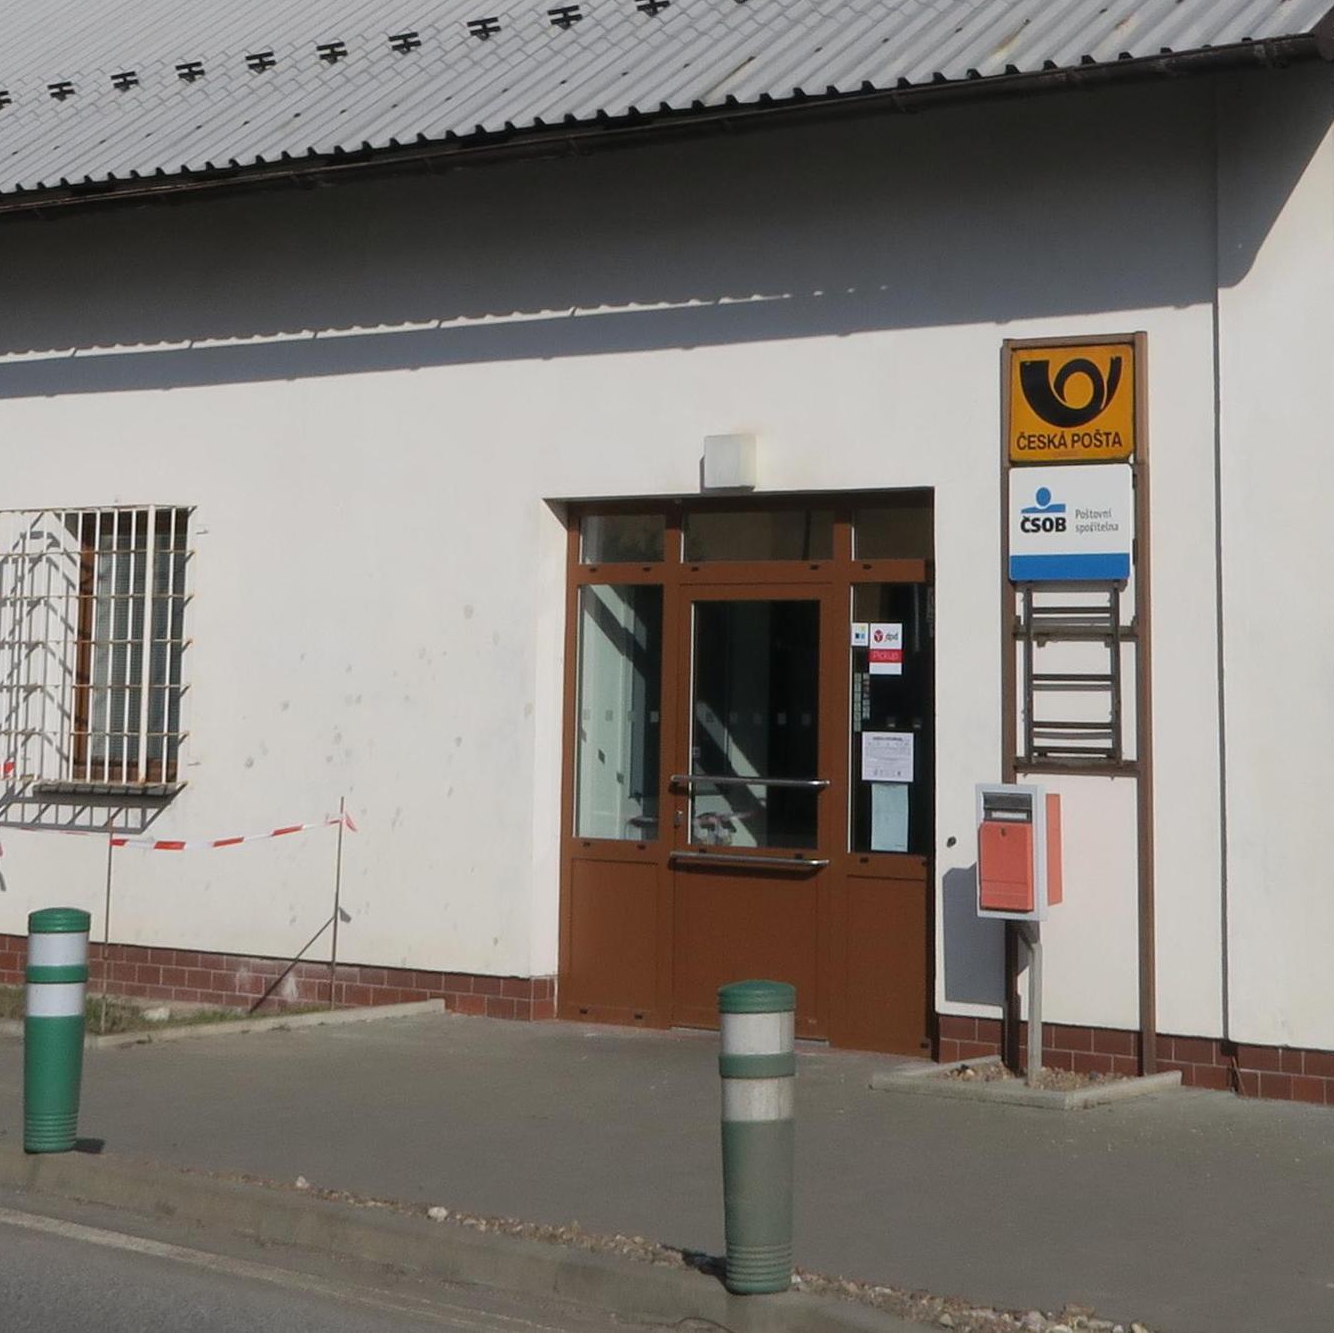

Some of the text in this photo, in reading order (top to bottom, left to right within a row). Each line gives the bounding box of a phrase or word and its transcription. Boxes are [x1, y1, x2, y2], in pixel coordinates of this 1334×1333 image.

[1016, 429, 1122, 450] ČESKÁ POŠTA
[1075, 508, 1112, 520] Poštovní
[1020, 516, 1067, 533] ČSOB
[1075, 521, 1119, 534] spořitelna
